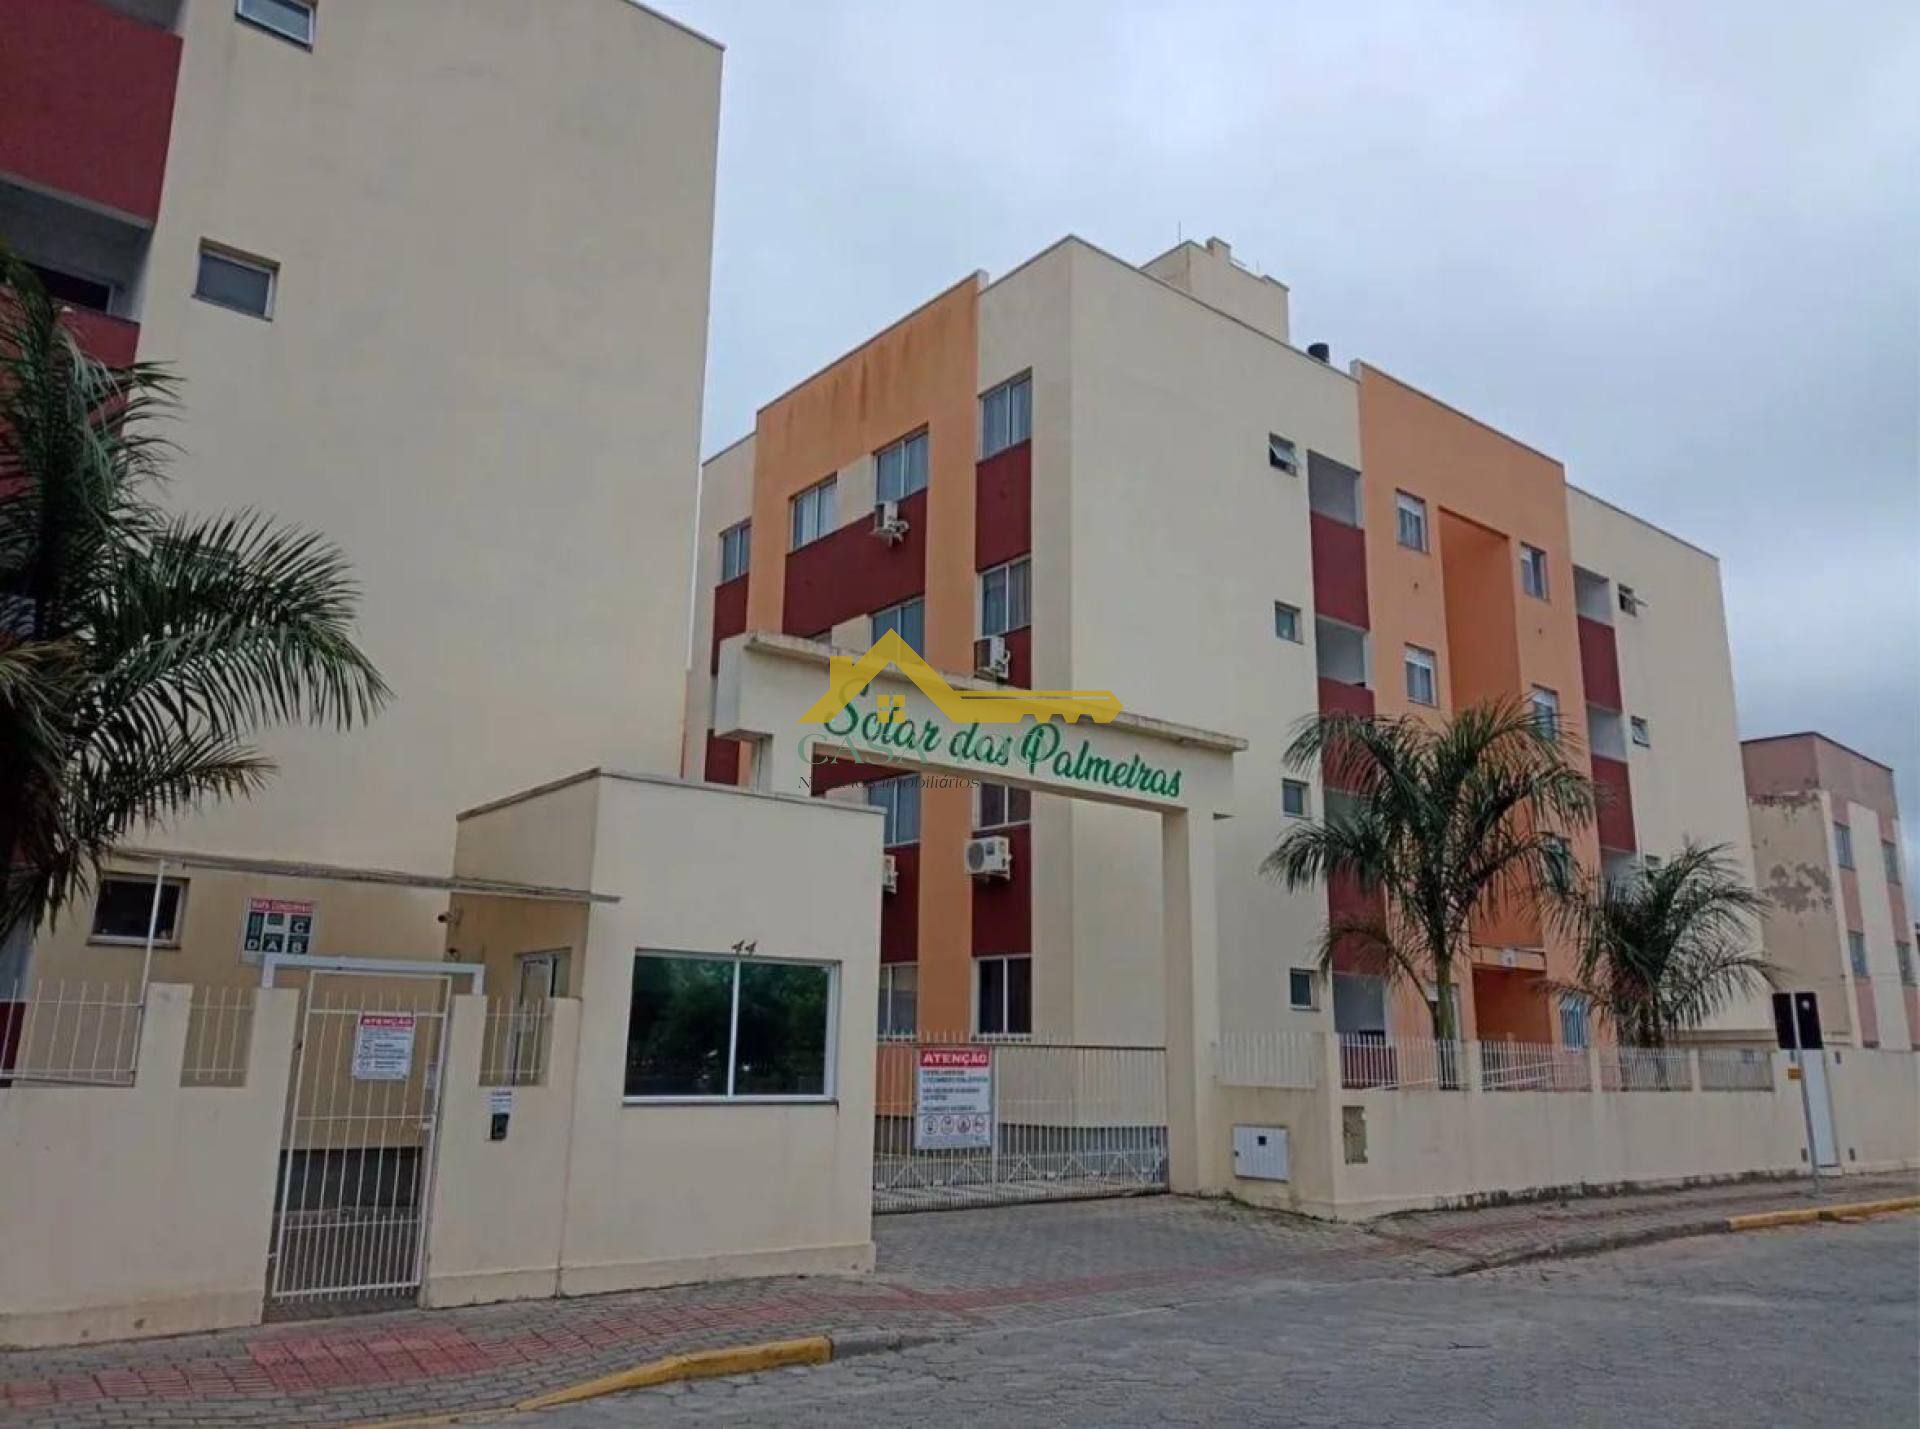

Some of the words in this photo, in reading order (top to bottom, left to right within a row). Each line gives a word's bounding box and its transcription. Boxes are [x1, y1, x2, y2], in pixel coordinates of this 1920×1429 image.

[823, 677, 941, 751] Solar
[949, 722, 1008, 765] das
[1021, 722, 1181, 797] Palmeiras
[923, 1052, 987, 1064] ATENÇÃO
